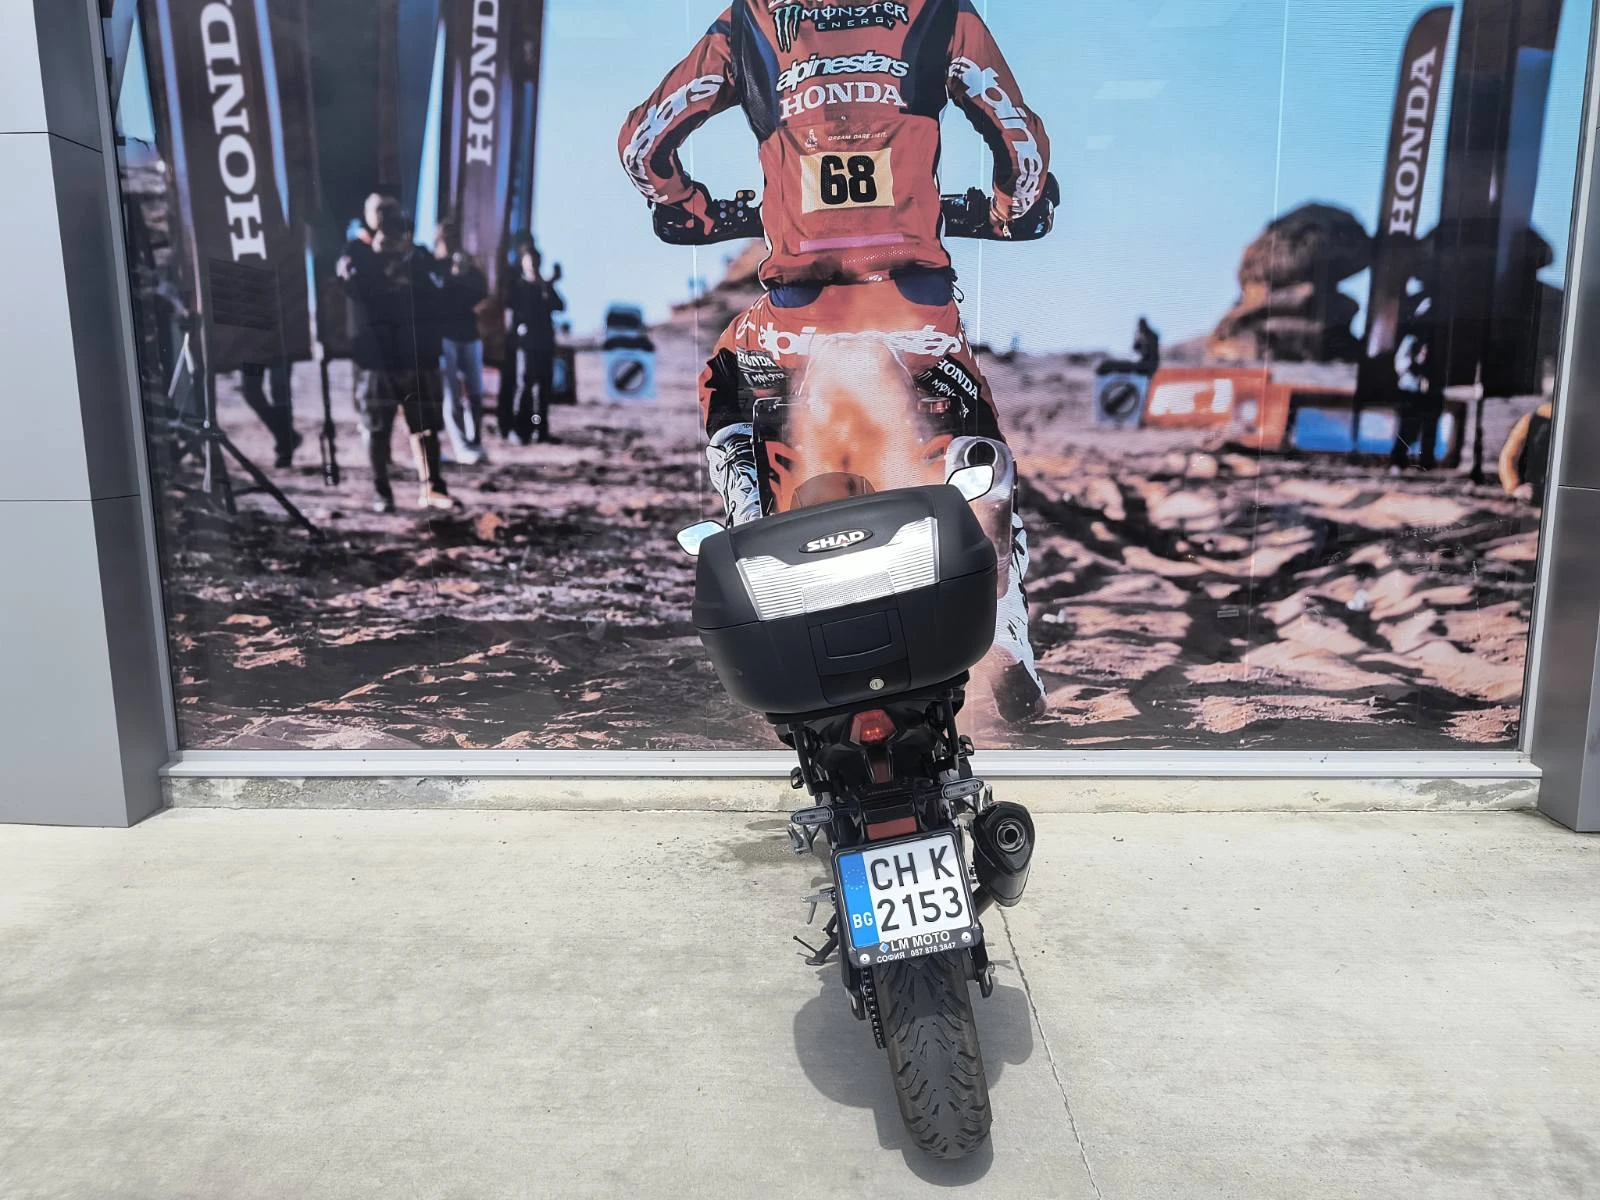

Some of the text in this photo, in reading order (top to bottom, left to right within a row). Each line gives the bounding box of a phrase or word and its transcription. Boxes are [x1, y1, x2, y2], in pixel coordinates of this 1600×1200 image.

[818, 17, 893, 29] ENERGY
[776, 51, 910, 92] alpinestars
[780, 81, 908, 119] HONDA
[200, 0, 267, 262] HOND
[1388, 47, 1437, 236] HONDA
[820, 155, 878, 205] 68
[936, 358, 978, 400] HONDA
[806, 531, 865, 552] SHAD
[870, 845, 955, 891] CH K
[852, 912, 873, 929] BG
[877, 886, 963, 932] 2153
[876, 951, 906, 963] СОФИЯ
[890, 930, 951, 952] LM MOTO
